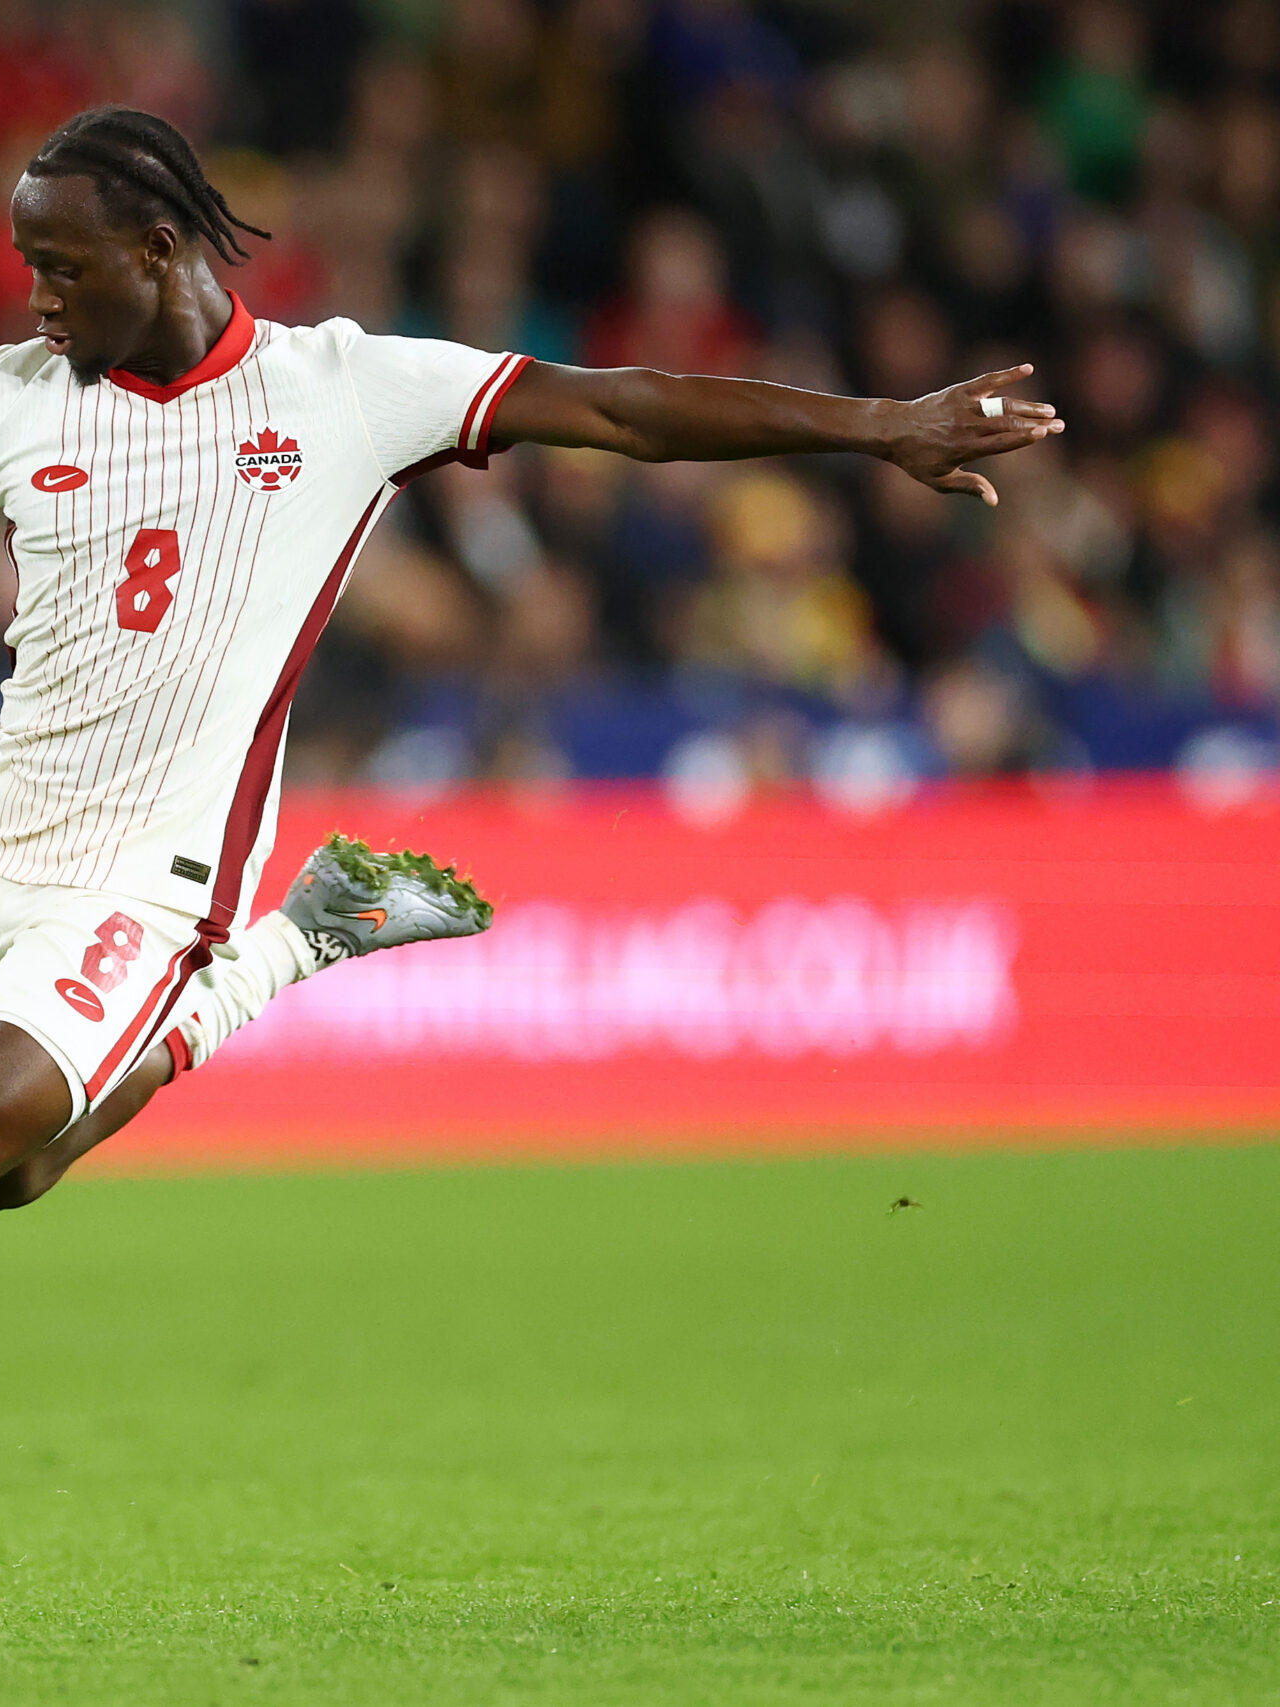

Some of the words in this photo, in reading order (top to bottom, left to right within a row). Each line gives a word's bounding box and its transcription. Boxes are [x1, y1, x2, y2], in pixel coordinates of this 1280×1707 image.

[235, 454, 303, 467] CANADA
[116, 528, 181, 633] 8
[81, 911, 144, 994] 8
